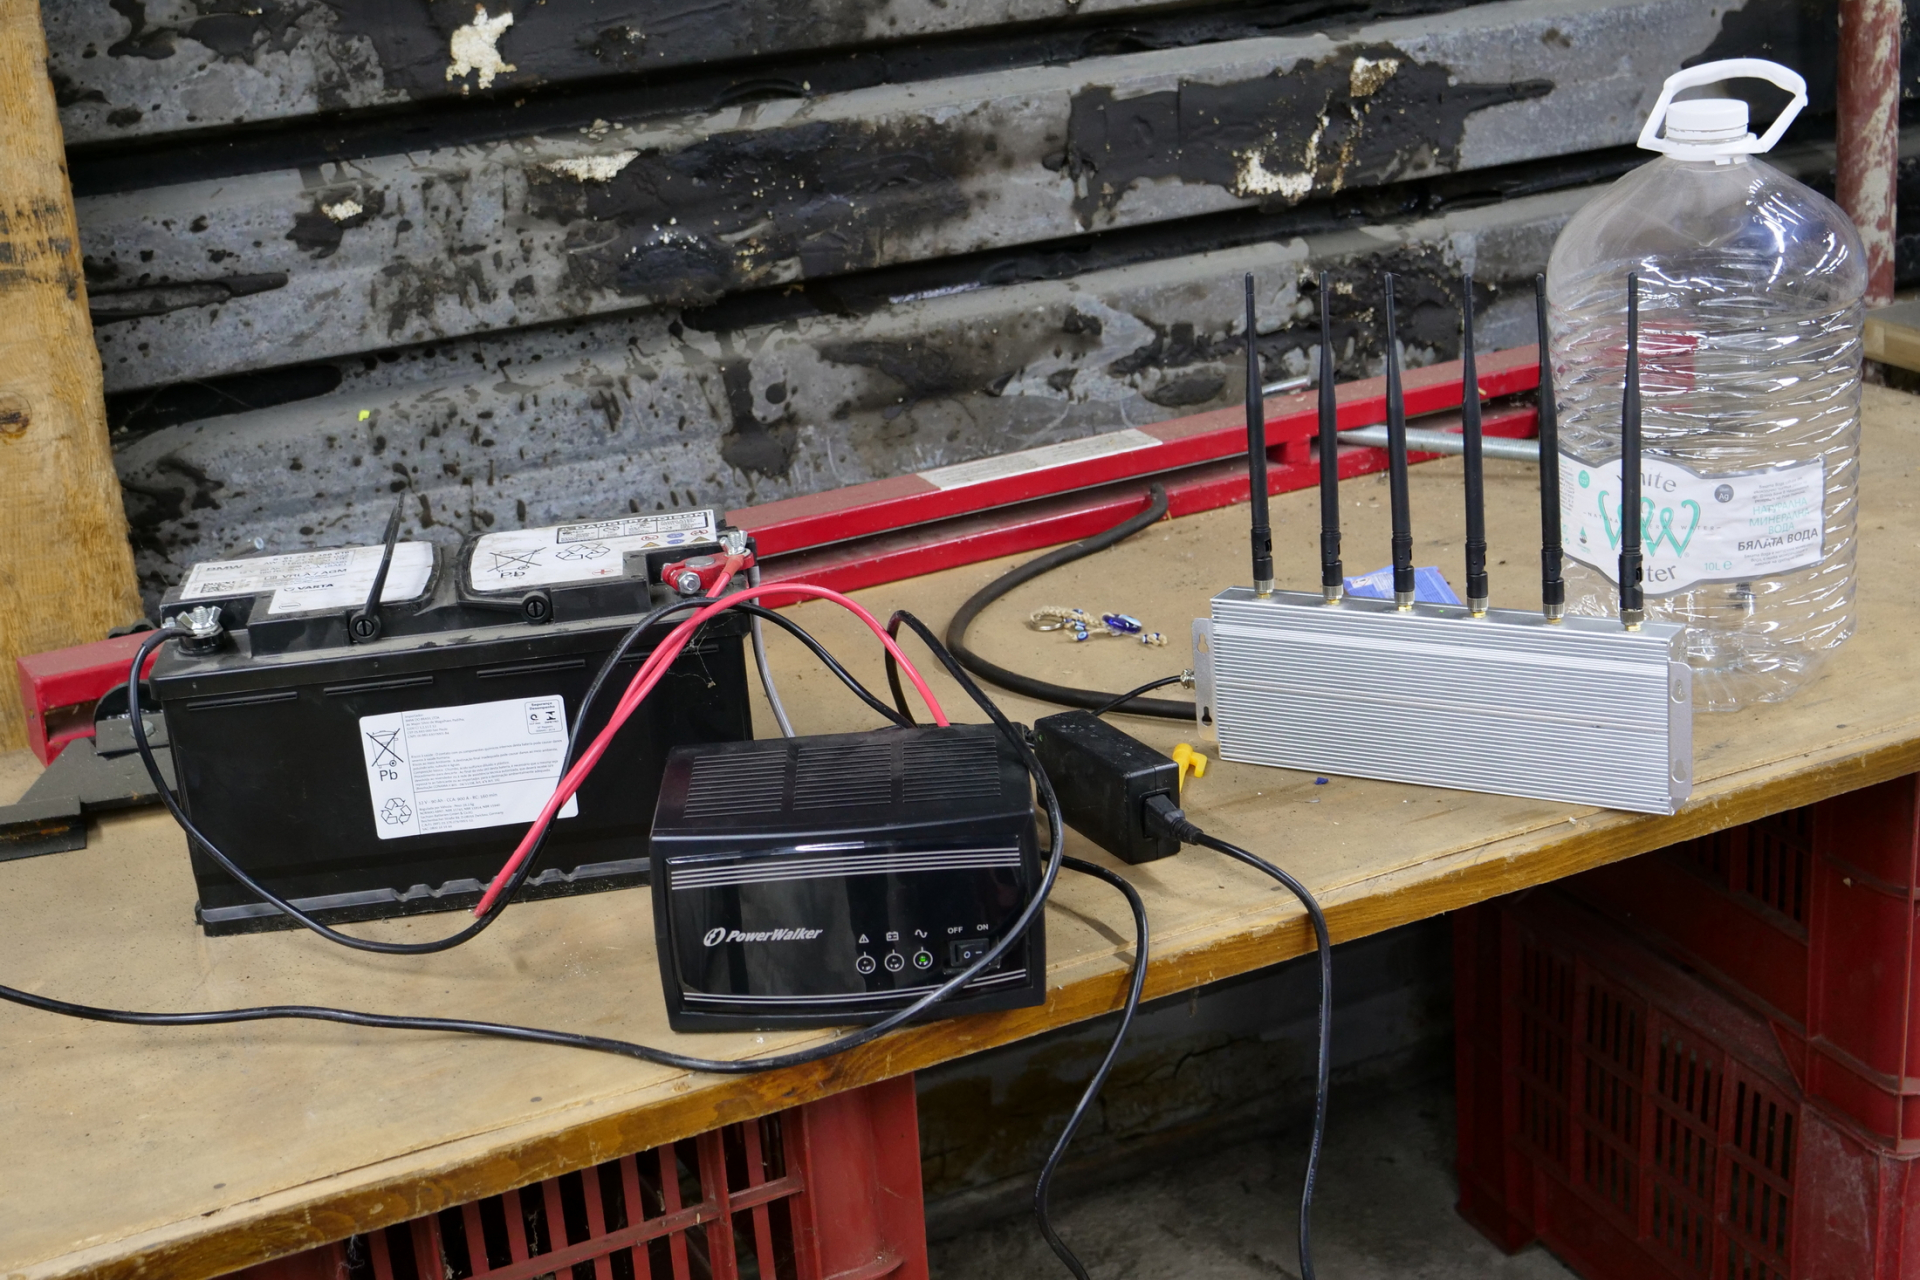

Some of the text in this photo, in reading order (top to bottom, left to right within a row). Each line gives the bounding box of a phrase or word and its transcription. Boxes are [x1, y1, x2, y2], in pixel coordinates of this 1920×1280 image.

[1718, 492, 1729, 501] Ag
[1752, 497, 1808, 515] НАТУРАЛНА
[1749, 508, 1810, 527] МИНЕРАЛНА
[1768, 522, 1795, 535] ВОДА
[1737, 527, 1819, 552] БЯЛАТА ВОДА
[297, 583, 334, 591] VARTA
[379, 769, 398, 781] Pb
[725, 926, 823, 943] PowerWalker
[947, 923, 989, 935] OFF ON
